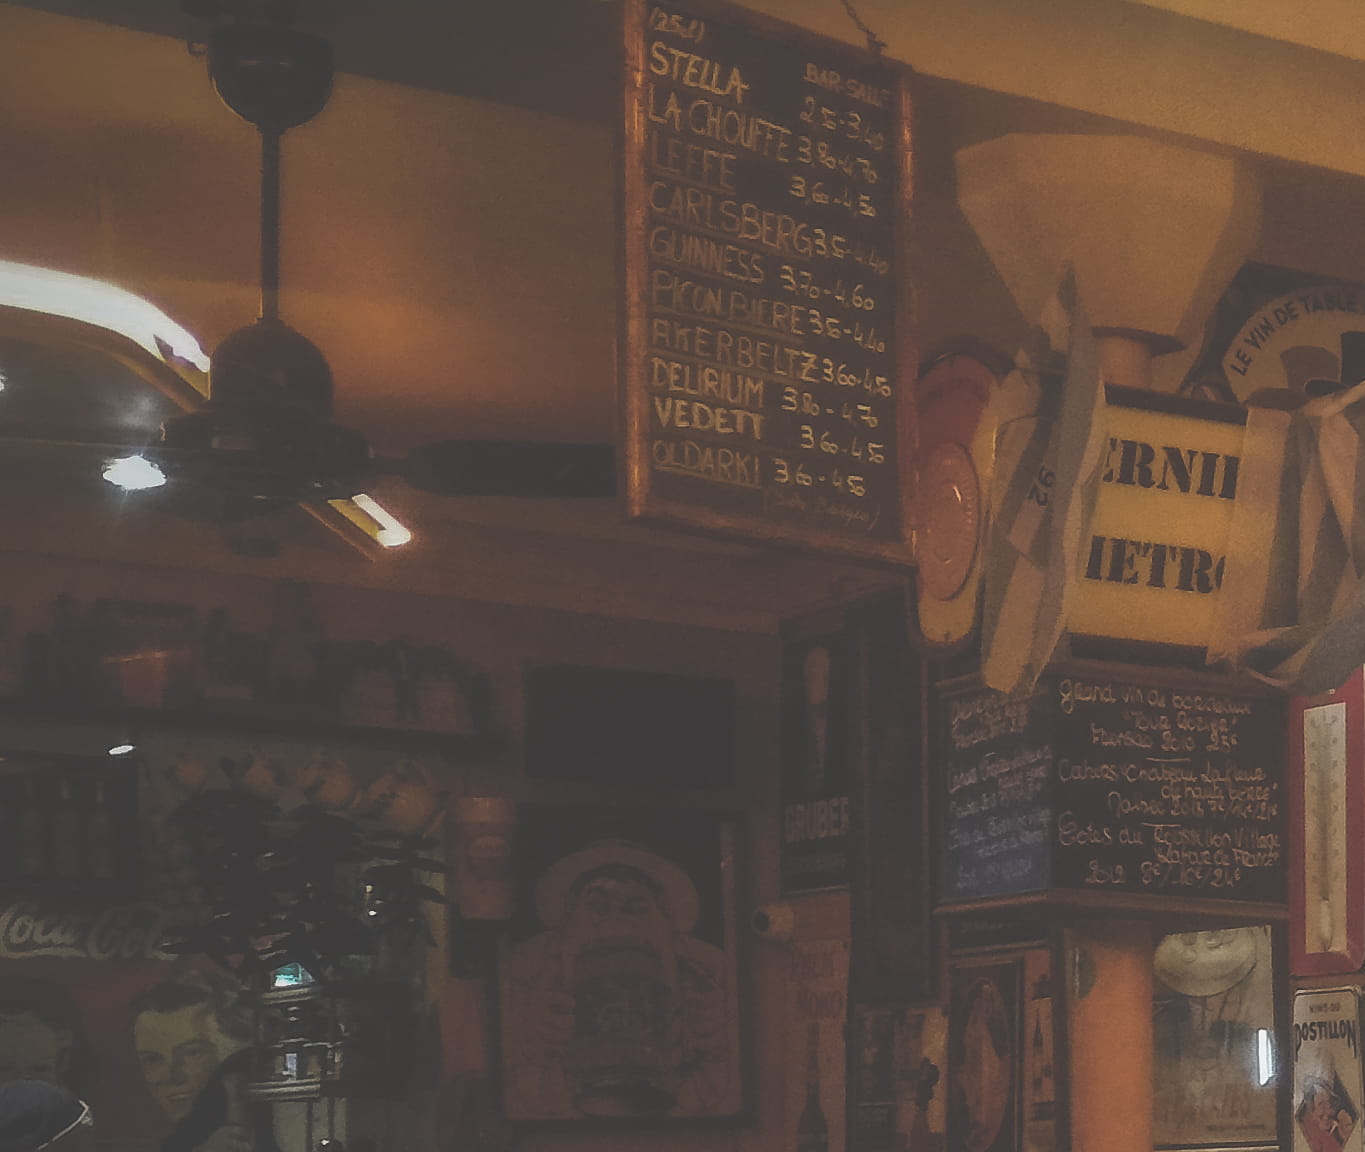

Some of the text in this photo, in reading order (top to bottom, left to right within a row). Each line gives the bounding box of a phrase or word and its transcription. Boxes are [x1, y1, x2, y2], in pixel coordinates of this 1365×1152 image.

[650, 41, 751, 104] STELLA
[648, 82, 793, 163] LA CHOUFFE
[651, 130, 737, 189] LEFFE
[650, 181, 812, 255] CARLSBERG
[650, 226, 765, 284] GUINNESS
[651, 270, 724, 316] PICON
[1243, 317, 1277, 351] VIN
[650, 356, 765, 409] DELIRIUM
[654, 395, 767, 441] VEDETT
[652, 439, 762, 486] OLDARKI
[1294, 1018, 1358, 1062] POSTILLON
